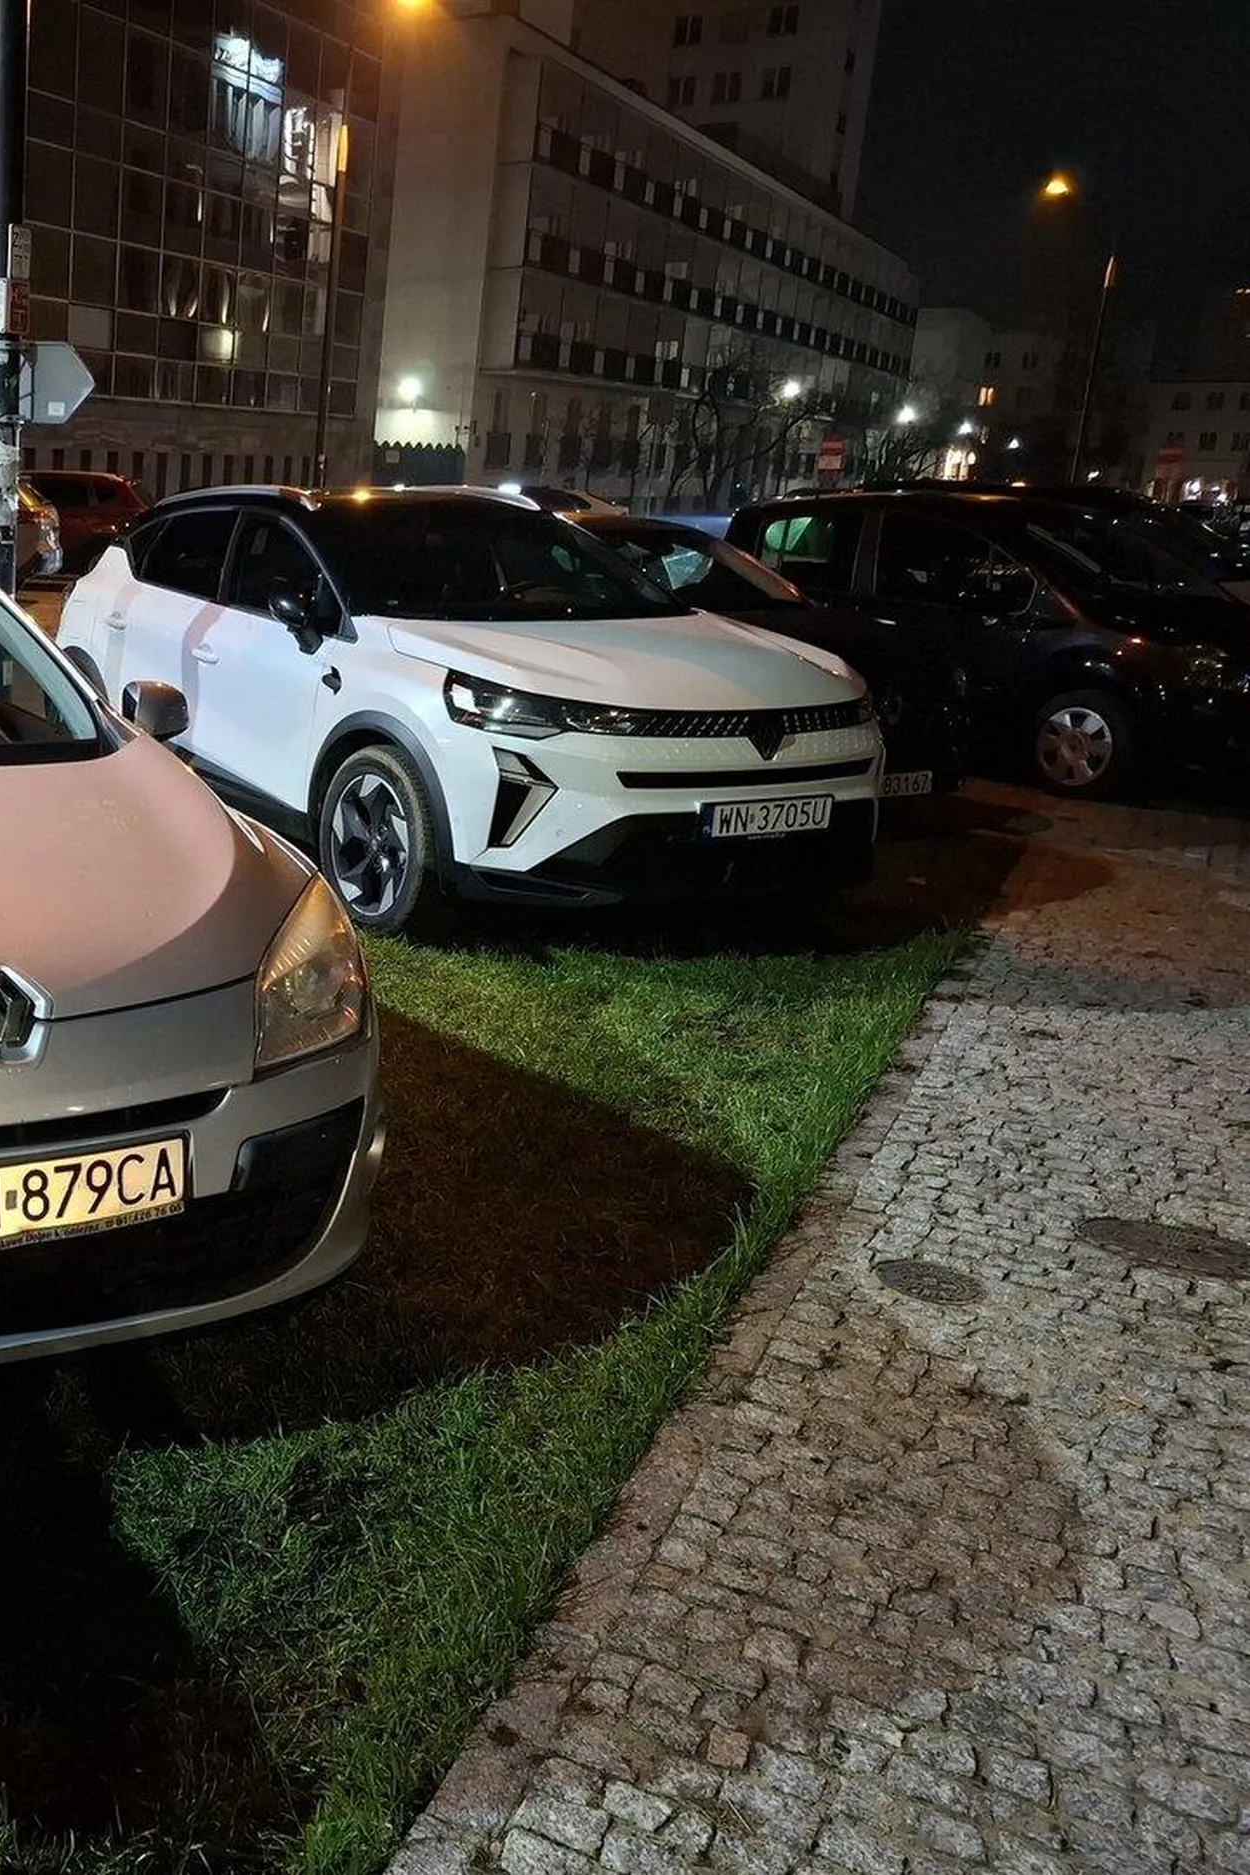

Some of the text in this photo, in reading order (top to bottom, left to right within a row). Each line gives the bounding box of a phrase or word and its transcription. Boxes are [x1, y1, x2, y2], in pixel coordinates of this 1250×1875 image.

[718, 797, 828, 834] WN 3705U
[21, 1147, 178, 1223] 879CA
